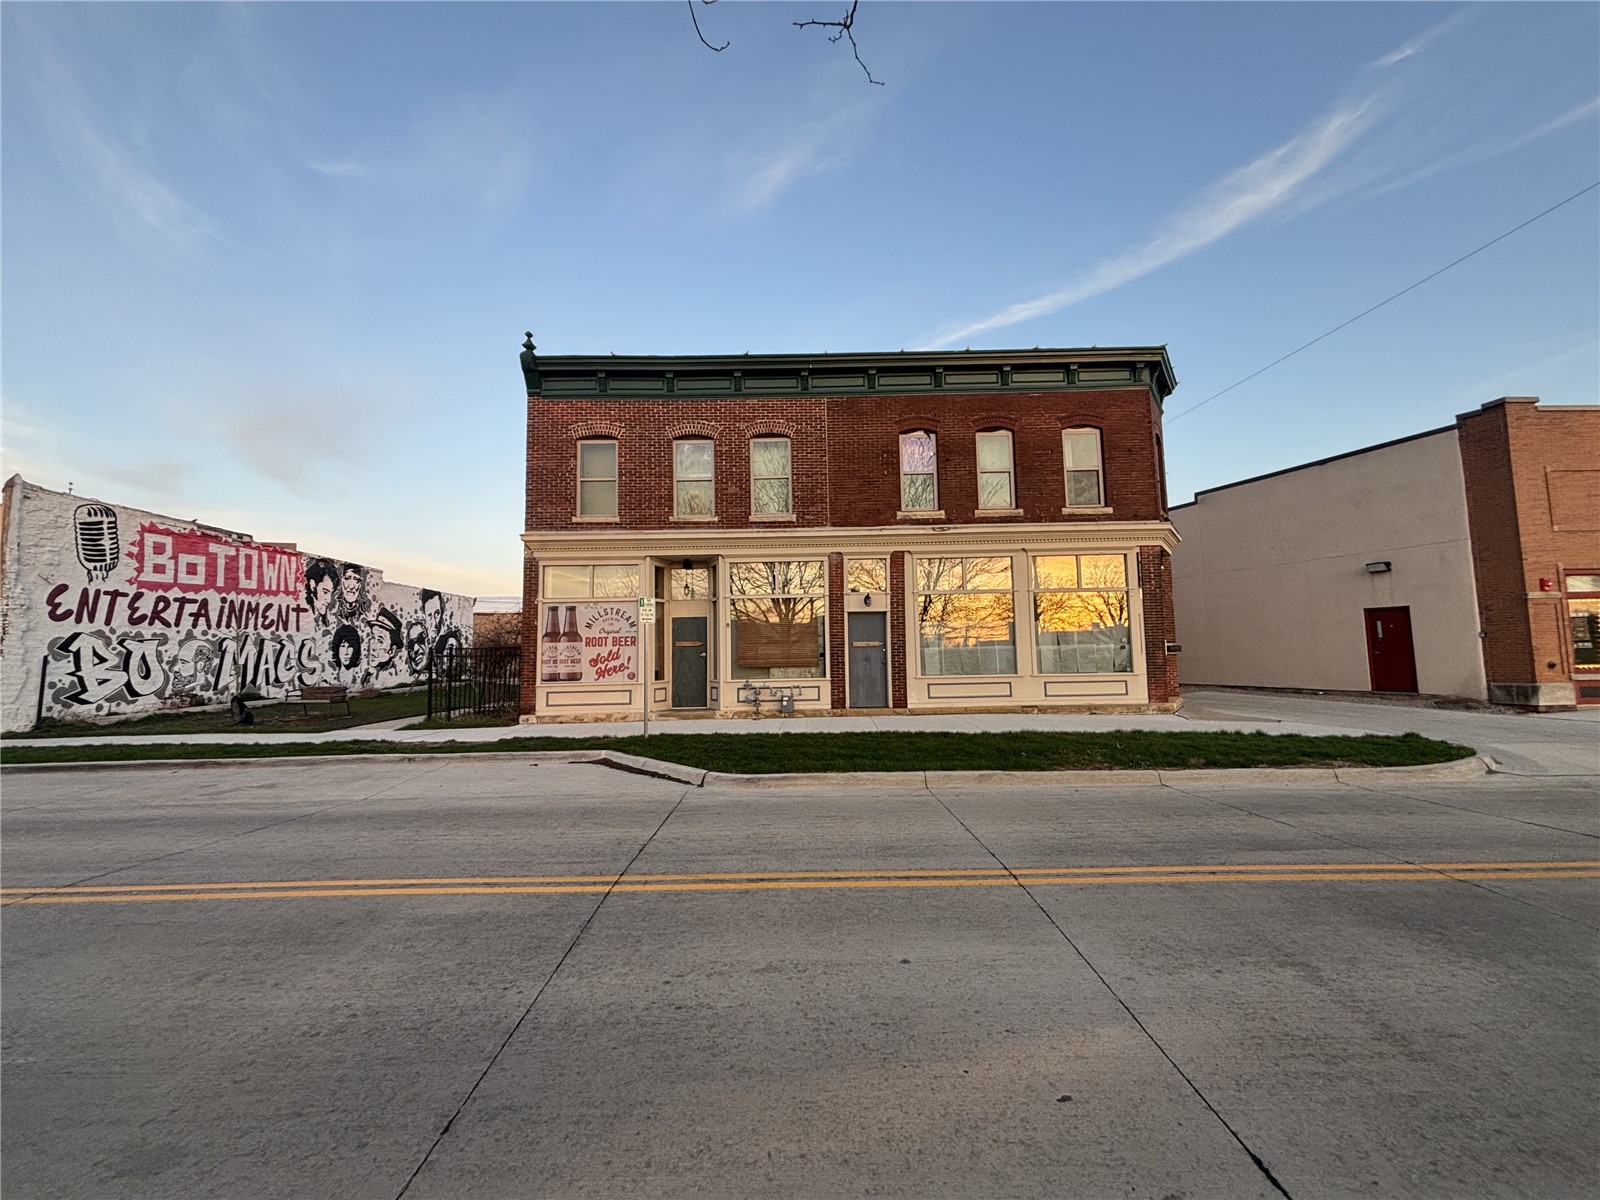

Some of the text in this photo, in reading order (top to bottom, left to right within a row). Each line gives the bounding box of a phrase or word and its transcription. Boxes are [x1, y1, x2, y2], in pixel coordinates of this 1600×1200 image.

[584, 607, 637, 630] MILLSTREAM
[584, 635, 637, 648] ROOT BEER
[588, 647, 622, 668] Sold
[593, 655, 632, 682] Here!
